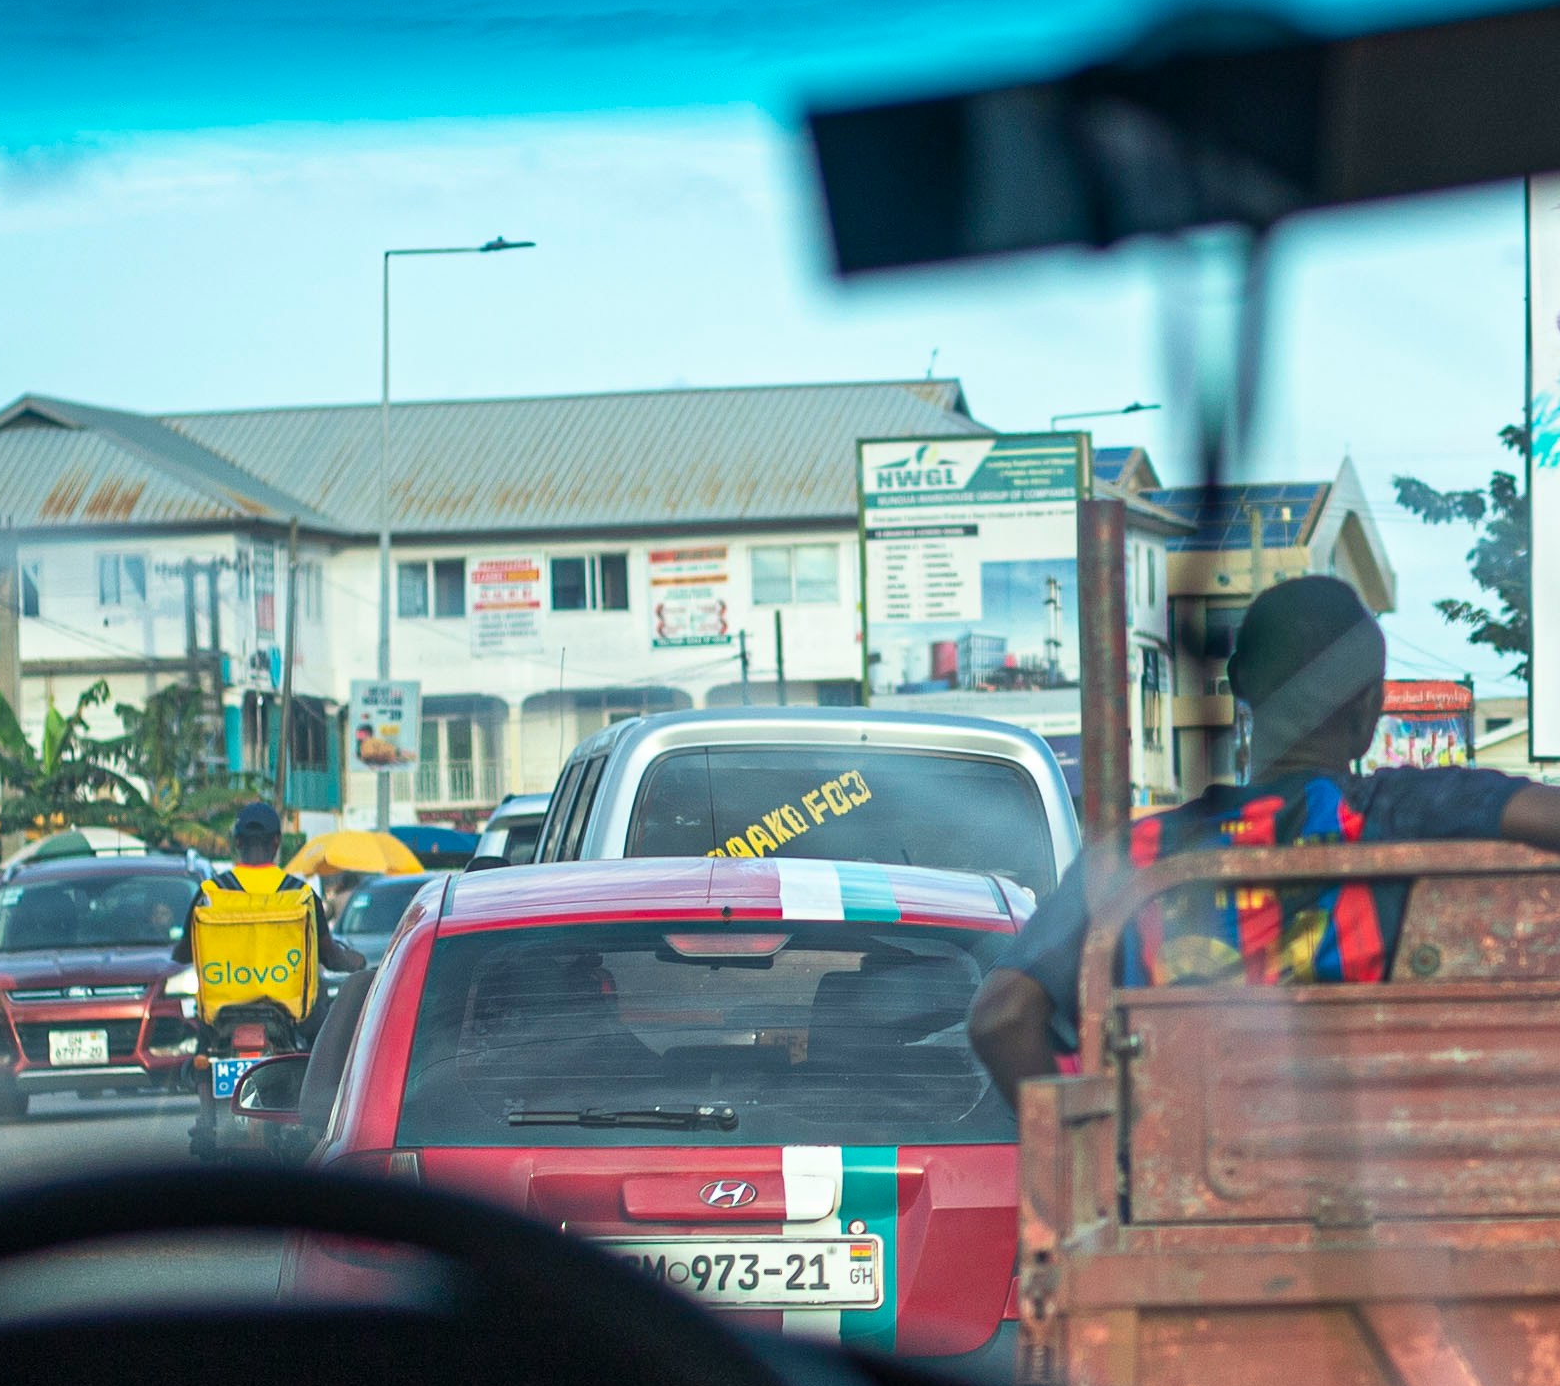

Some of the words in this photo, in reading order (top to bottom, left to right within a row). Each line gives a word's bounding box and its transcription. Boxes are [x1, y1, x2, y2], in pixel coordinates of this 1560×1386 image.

[876, 467, 958, 490] NWGL
[201, 961, 289, 986] Glovo
[691, 1253, 831, 1291] 973-21
[849, 1267, 873, 1285] GH
